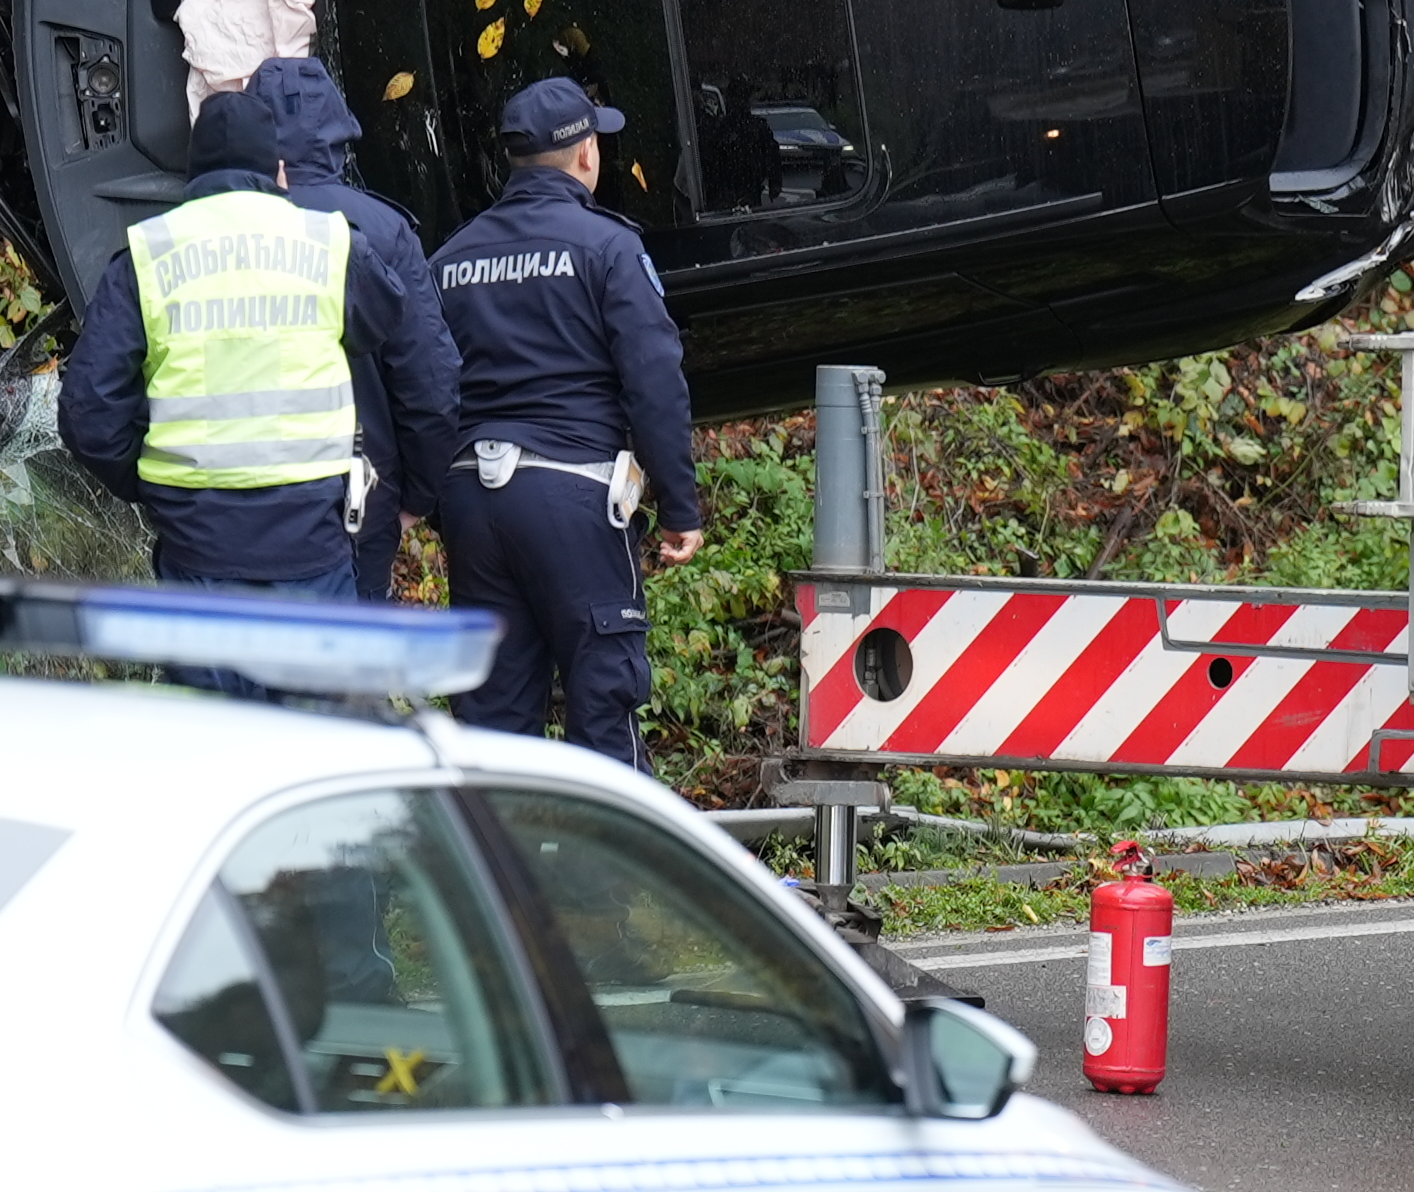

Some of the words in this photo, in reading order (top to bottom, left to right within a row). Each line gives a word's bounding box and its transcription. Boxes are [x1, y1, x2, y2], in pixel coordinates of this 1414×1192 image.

[155, 233, 329, 299] САОБРАЋАЈНА
[442, 250, 575, 290] ПОЛИЦИЈА
[165, 294, 318, 335] ПОЛИЦИЈА
